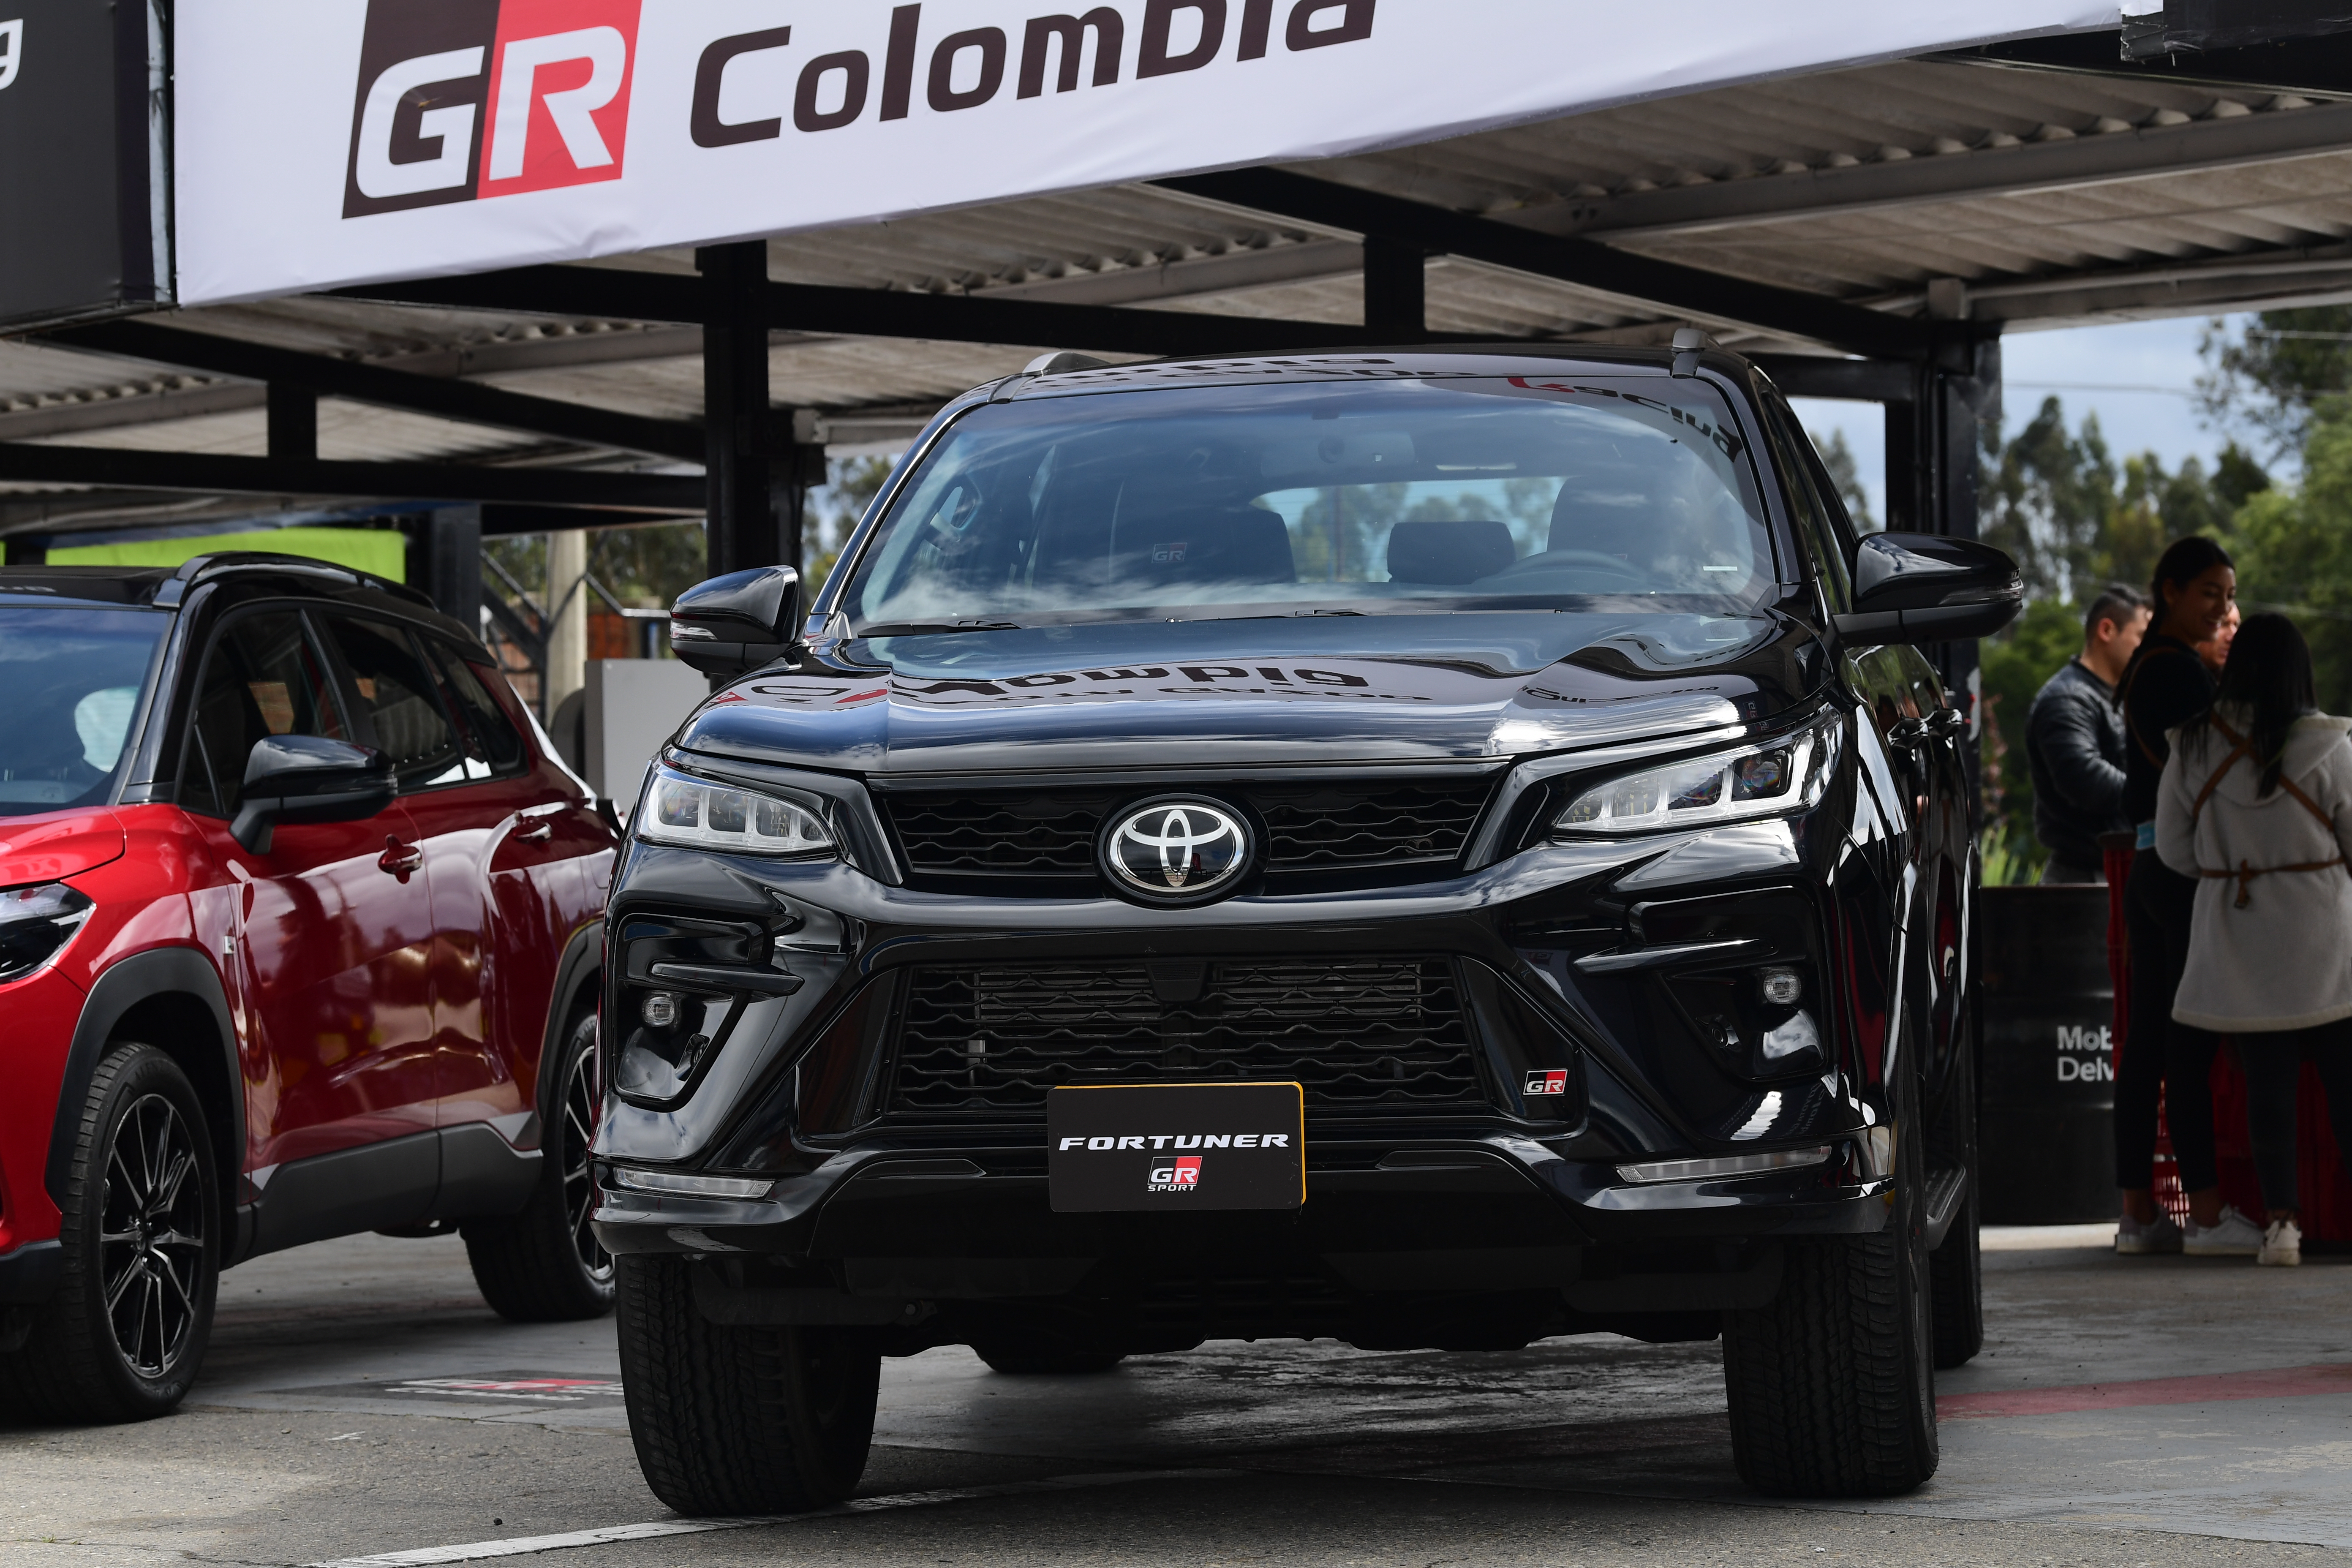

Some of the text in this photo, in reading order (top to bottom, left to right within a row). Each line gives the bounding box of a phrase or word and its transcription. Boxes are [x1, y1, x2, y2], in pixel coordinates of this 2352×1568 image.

[356, 0, 1376, 199] GR Colombia
[1154, 550, 1184, 561] GR
[2057, 1025, 2113, 1051] Mob
[2058, 1056, 2115, 1082] Delv
[1526, 1079, 1563, 1093] GR
[1059, 1134, 1289, 1151] FORTUNER
[1150, 1167, 1198, 1183] GR
